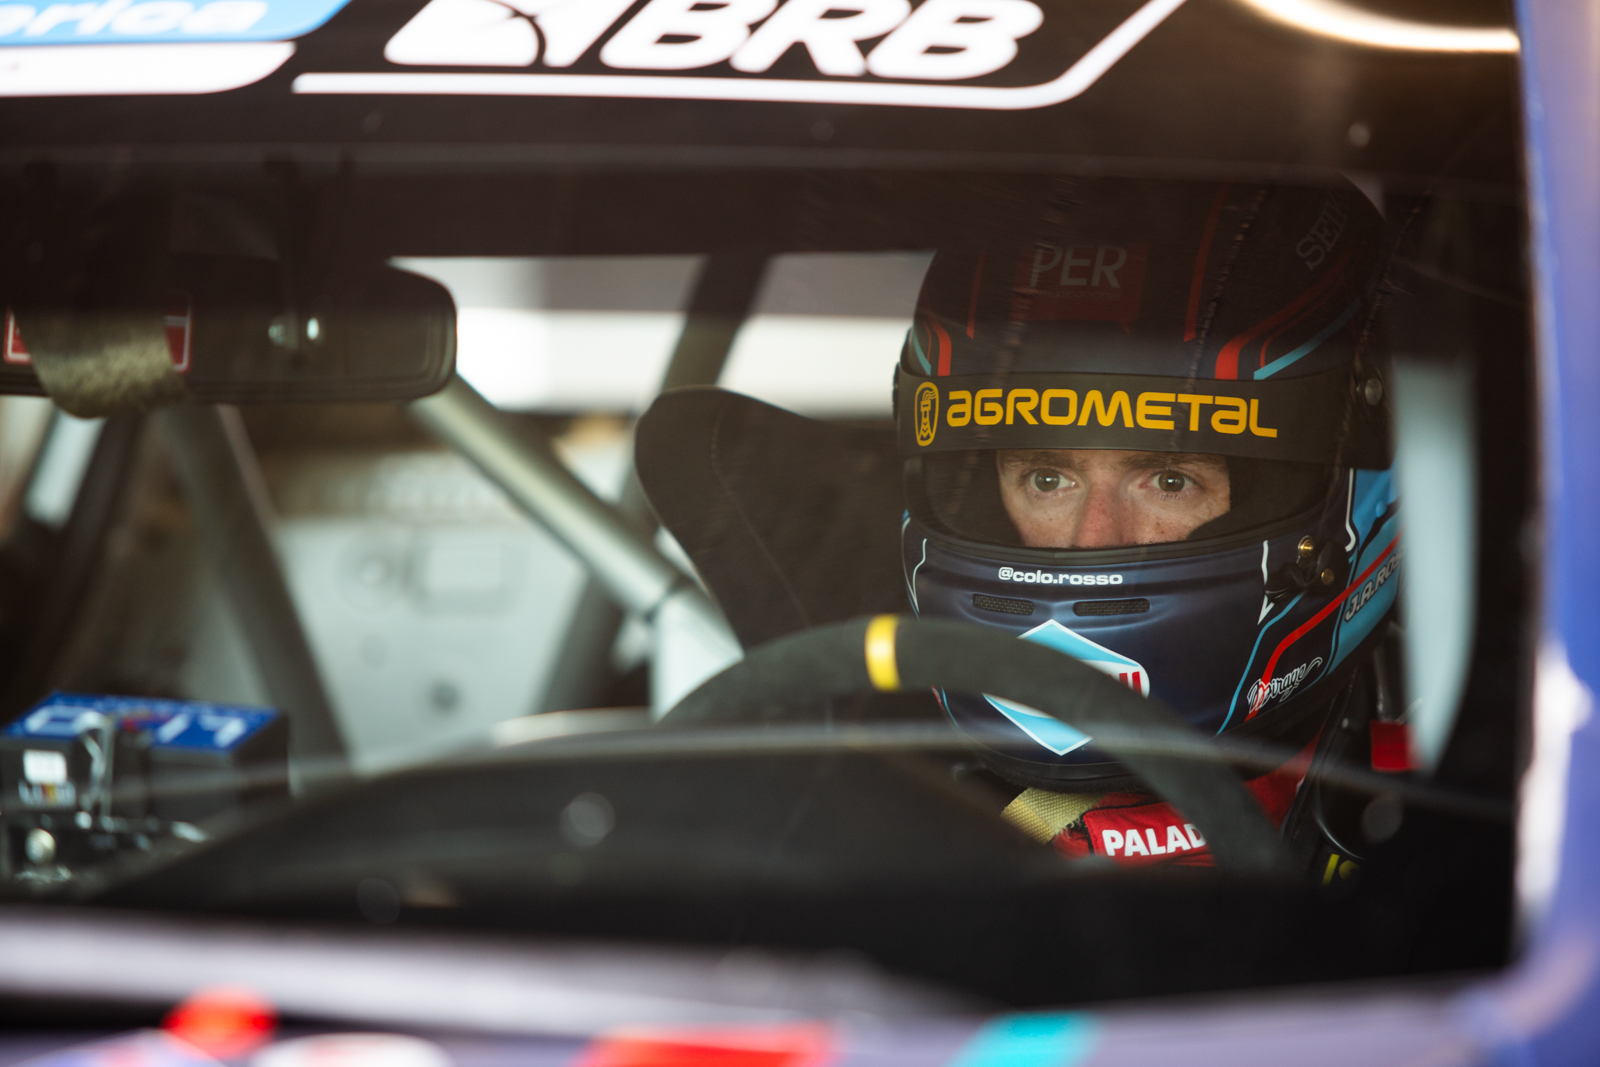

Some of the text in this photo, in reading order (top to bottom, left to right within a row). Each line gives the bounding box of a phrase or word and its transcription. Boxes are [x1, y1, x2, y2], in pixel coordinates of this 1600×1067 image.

[600, 0, 1044, 80] BRB
[1029, 243, 1128, 289] PER
[1029, 289, 1122, 302] omunicaciones
[998, 566, 1123, 585] @colo.rosso
